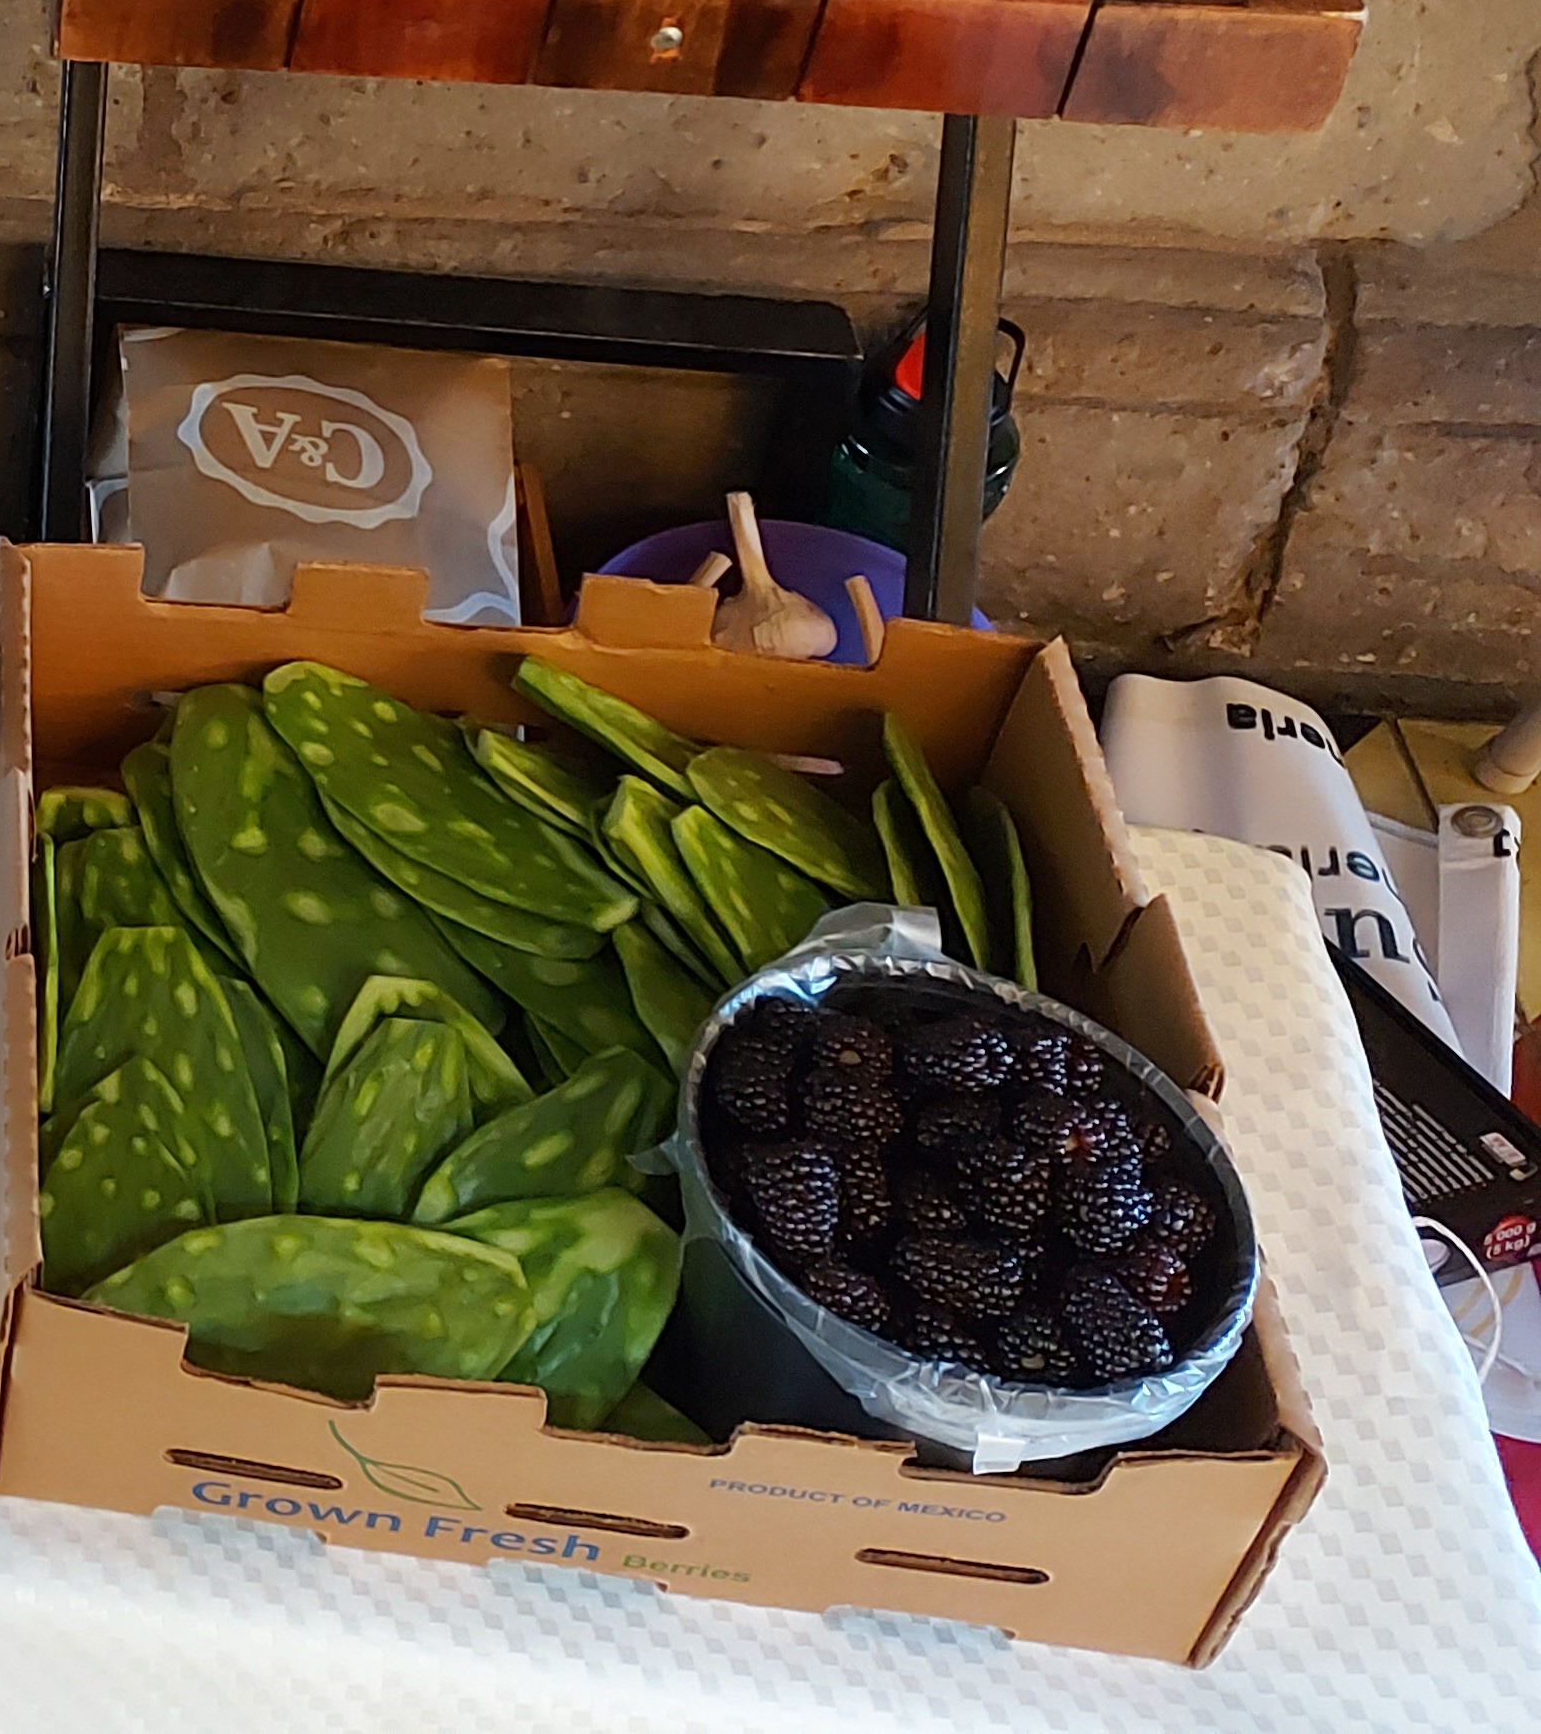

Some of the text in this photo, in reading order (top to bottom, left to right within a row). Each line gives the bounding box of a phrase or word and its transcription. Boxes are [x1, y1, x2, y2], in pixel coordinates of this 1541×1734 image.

[222, 402, 385, 489] C&A
[1496, 1224, 1523, 1242] 000
[192, 1481, 600, 1561] Grown Fresh
[710, 1479, 1007, 1523] PRODUCT OF MEXICO
[623, 1554, 751, 1583] Berries
